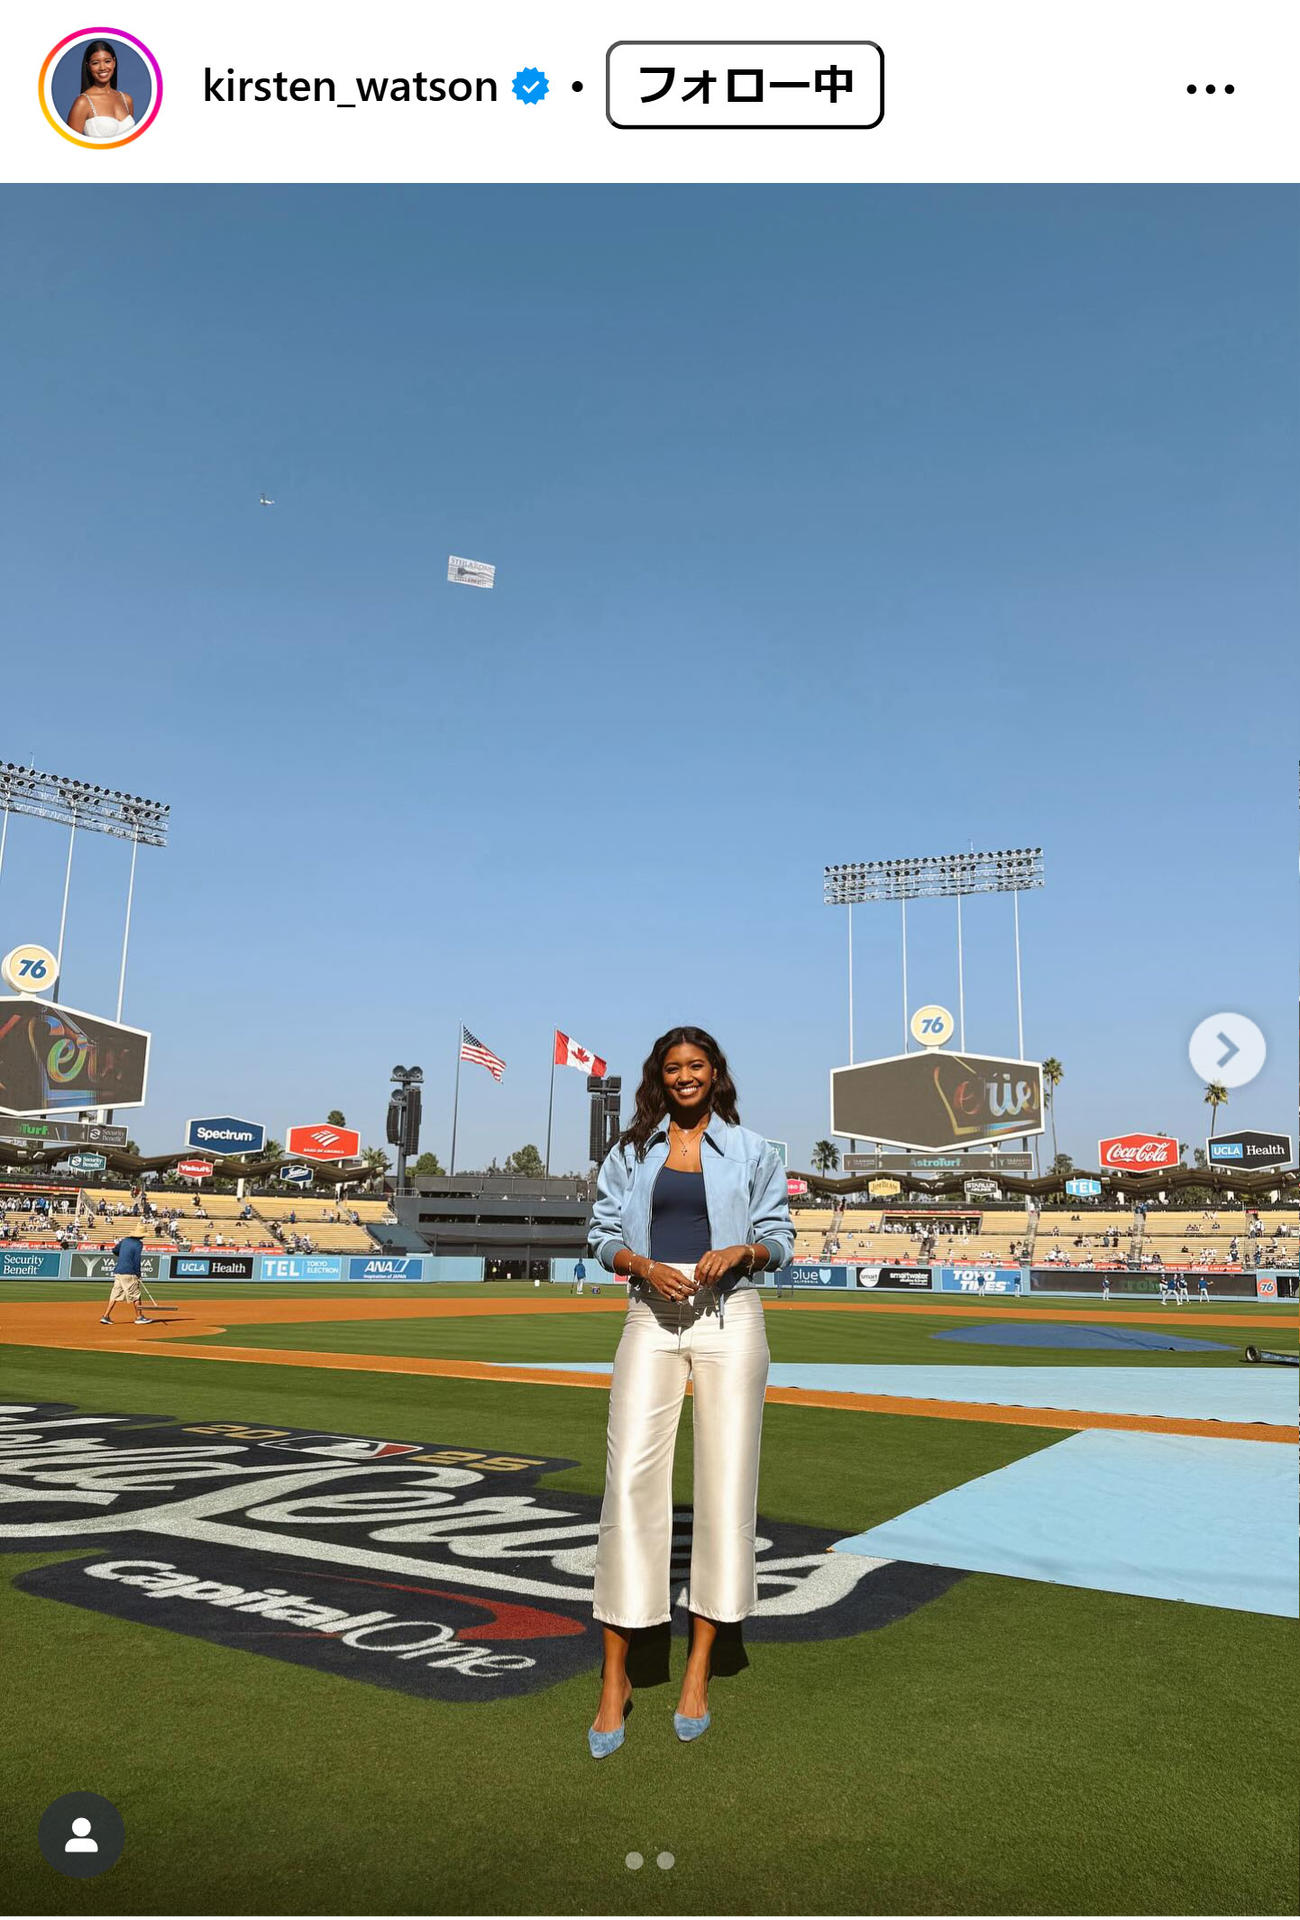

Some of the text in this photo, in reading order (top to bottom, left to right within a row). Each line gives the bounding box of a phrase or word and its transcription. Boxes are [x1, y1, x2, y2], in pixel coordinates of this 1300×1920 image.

[18, 959, 47, 979] 76
[921, 1017, 945, 1034] 76
[197, 1127, 253, 1142] Spectrum
[1106, 1142, 1170, 1163] Coca-Cola
[1213, 1144, 1286, 1156] UCLA Health
[1071, 1182, 1097, 1193] TEL
[4, 1254, 45, 1267] Security
[364, 1261, 394, 1273] ANA
[3, 1265, 38, 1275] Benefit
[181, 1263, 246, 1273] UCLA Health
[264, 1261, 300, 1277] TEL
[1261, 1283, 1274, 1292] 76
[181, 1424, 548, 1472] 20 25
